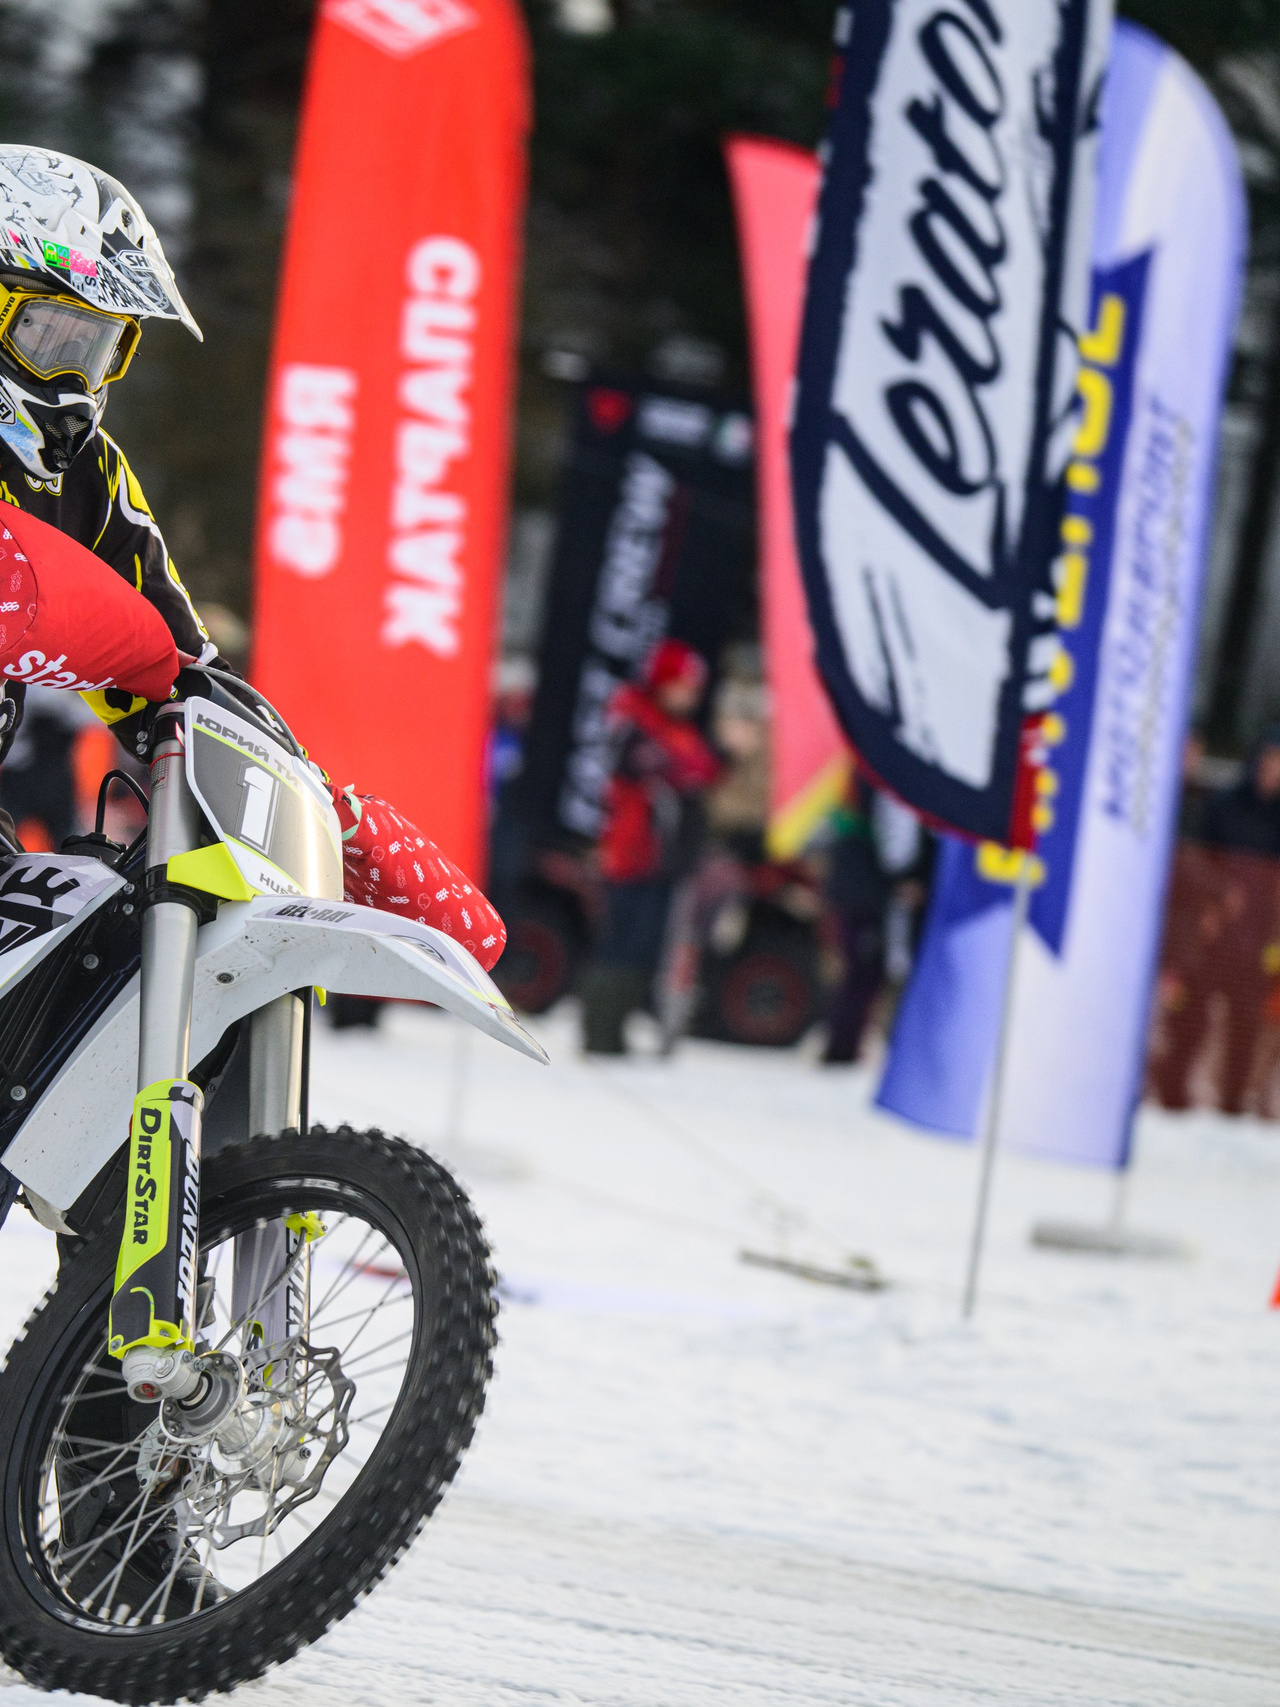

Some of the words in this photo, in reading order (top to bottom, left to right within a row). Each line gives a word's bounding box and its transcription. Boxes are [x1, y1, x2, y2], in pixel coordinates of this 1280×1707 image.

[196, 713, 270, 763] ЮРИЙ
[237, 762, 282, 858] 1
[178, 1138, 201, 1326] DUNLOP
